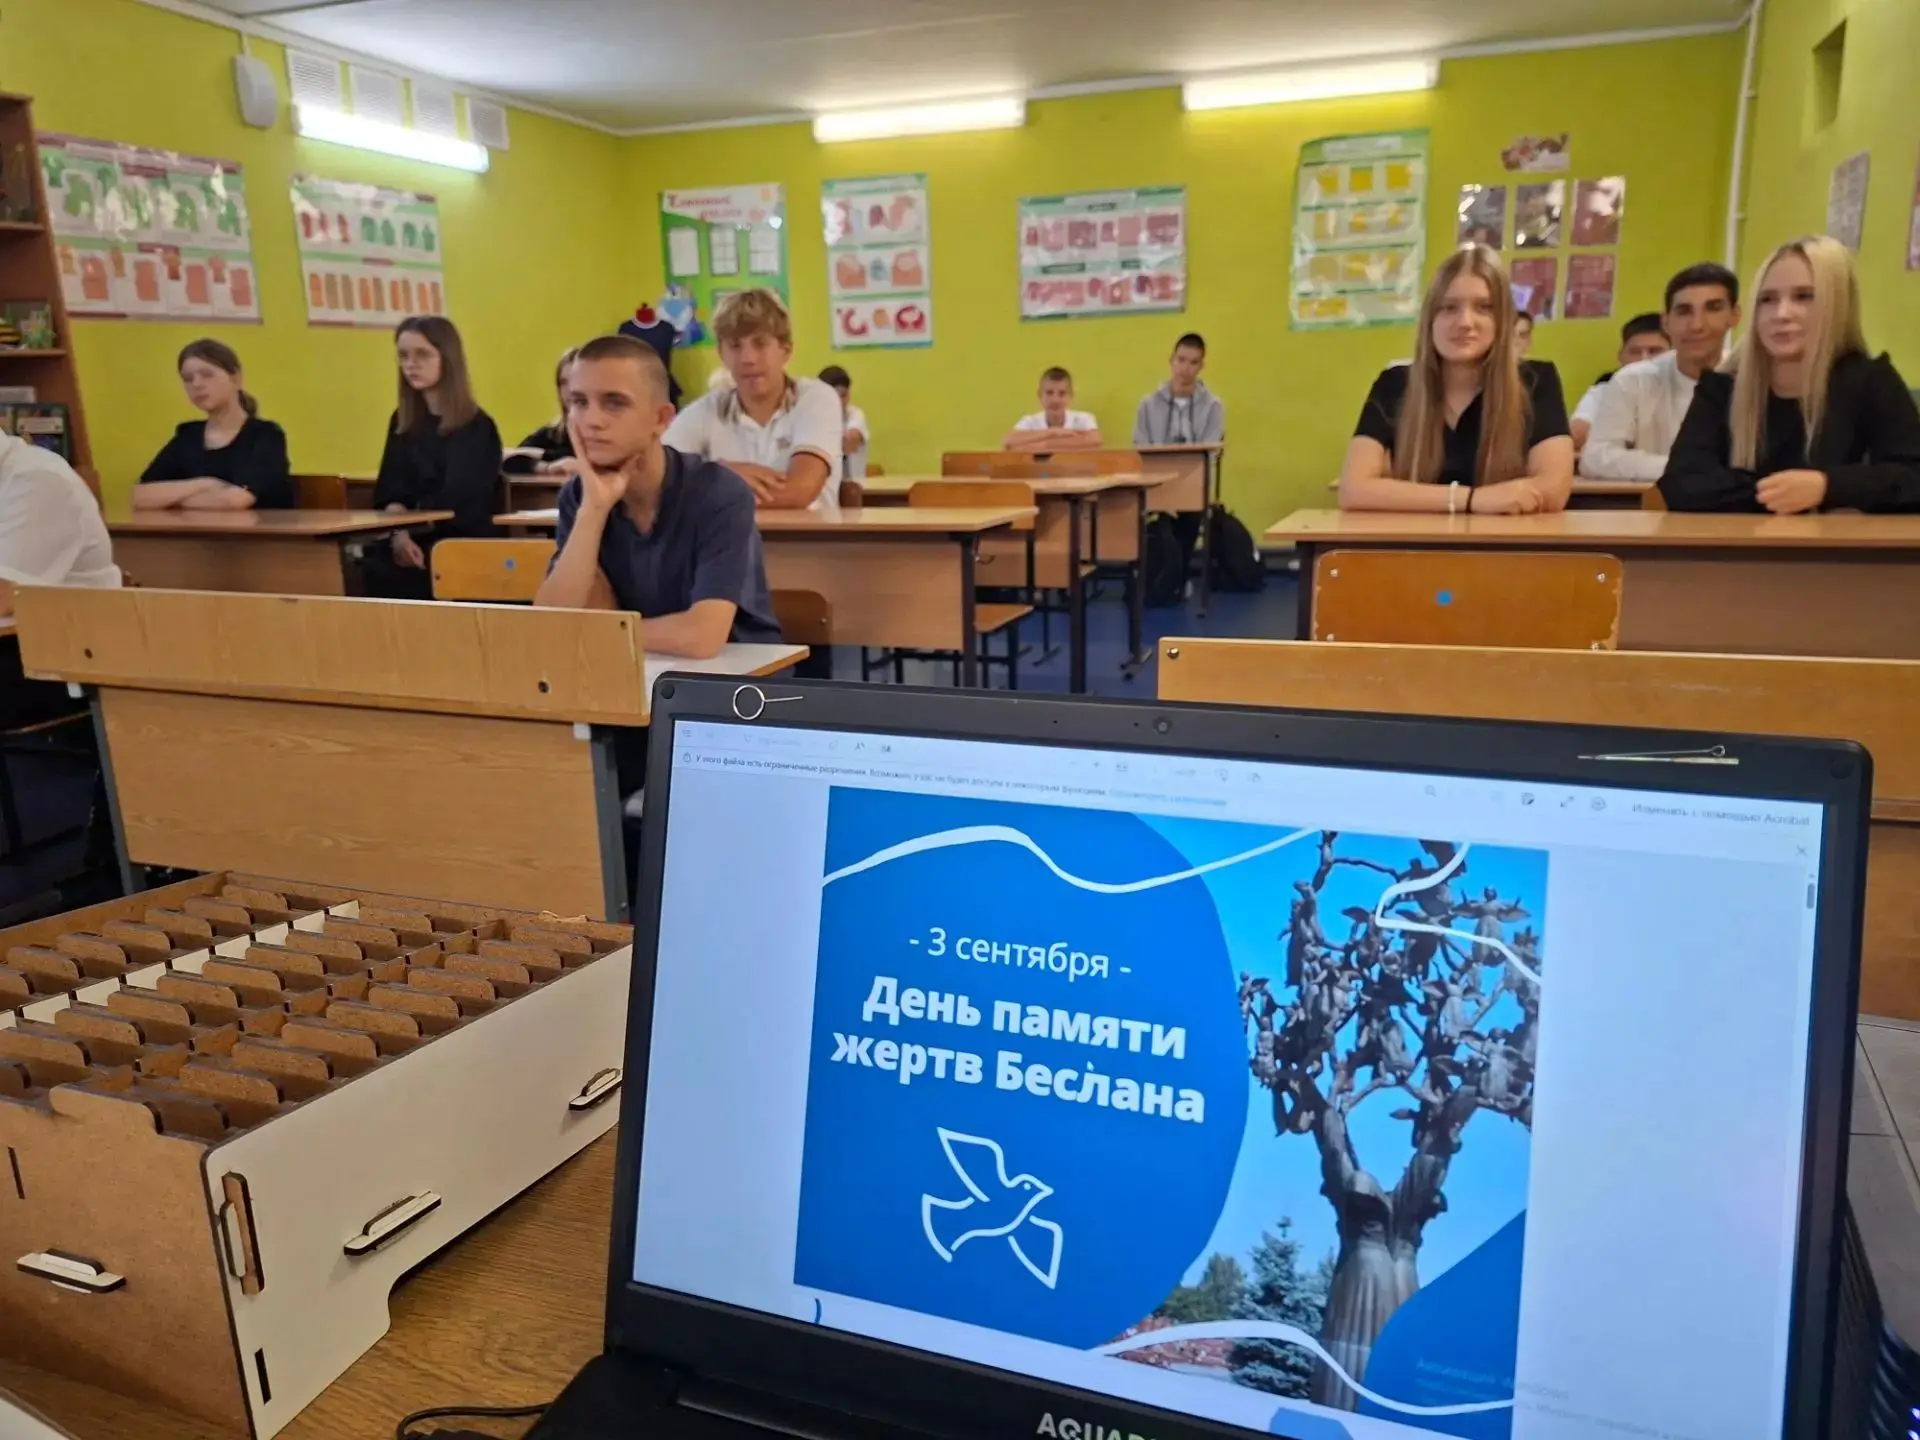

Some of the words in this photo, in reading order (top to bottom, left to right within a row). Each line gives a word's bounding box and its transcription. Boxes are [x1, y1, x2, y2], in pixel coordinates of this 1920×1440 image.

[723, 756, 746, 767] файла
[927, 927, 947, 956] 3
[955, 935, 1109, 982] сентября
[861, 975, 982, 1027] День
[993, 999, 1187, 1060] памяти
[830, 1032, 983, 1086] жертв
[995, 1050, 1205, 1124] Беслана
